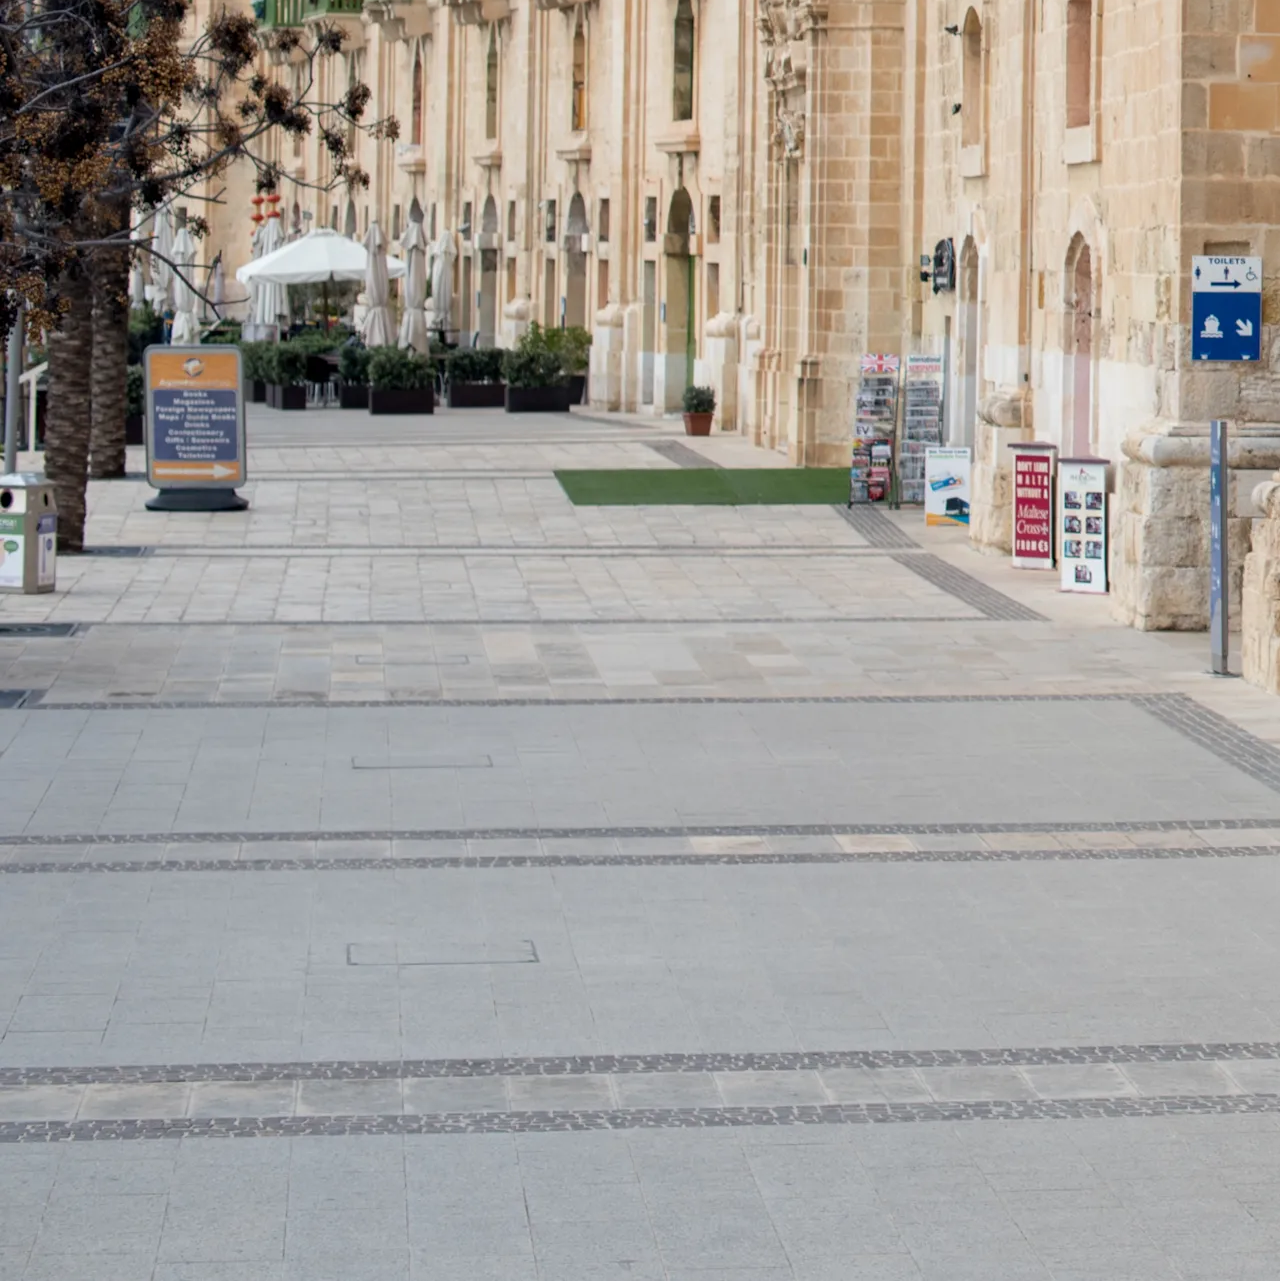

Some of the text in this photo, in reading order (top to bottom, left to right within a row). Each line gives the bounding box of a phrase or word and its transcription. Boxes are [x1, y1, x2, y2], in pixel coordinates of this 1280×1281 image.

[173, 398, 216, 406] Magazines
[155, 406, 236, 414] Foreign Newspapers
[165, 436, 185, 444] Gifts
[191, 436, 230, 444] Souvenirs
[175, 444, 217, 452] Cosmetics
[1017, 474, 1048, 486] MALTA
[1017, 487, 1048, 499] WITHOUT A
[1017, 504, 1048, 519] Maltese
[1016, 519, 1041, 535] Cross
[1017, 539, 1037, 551] FROM
